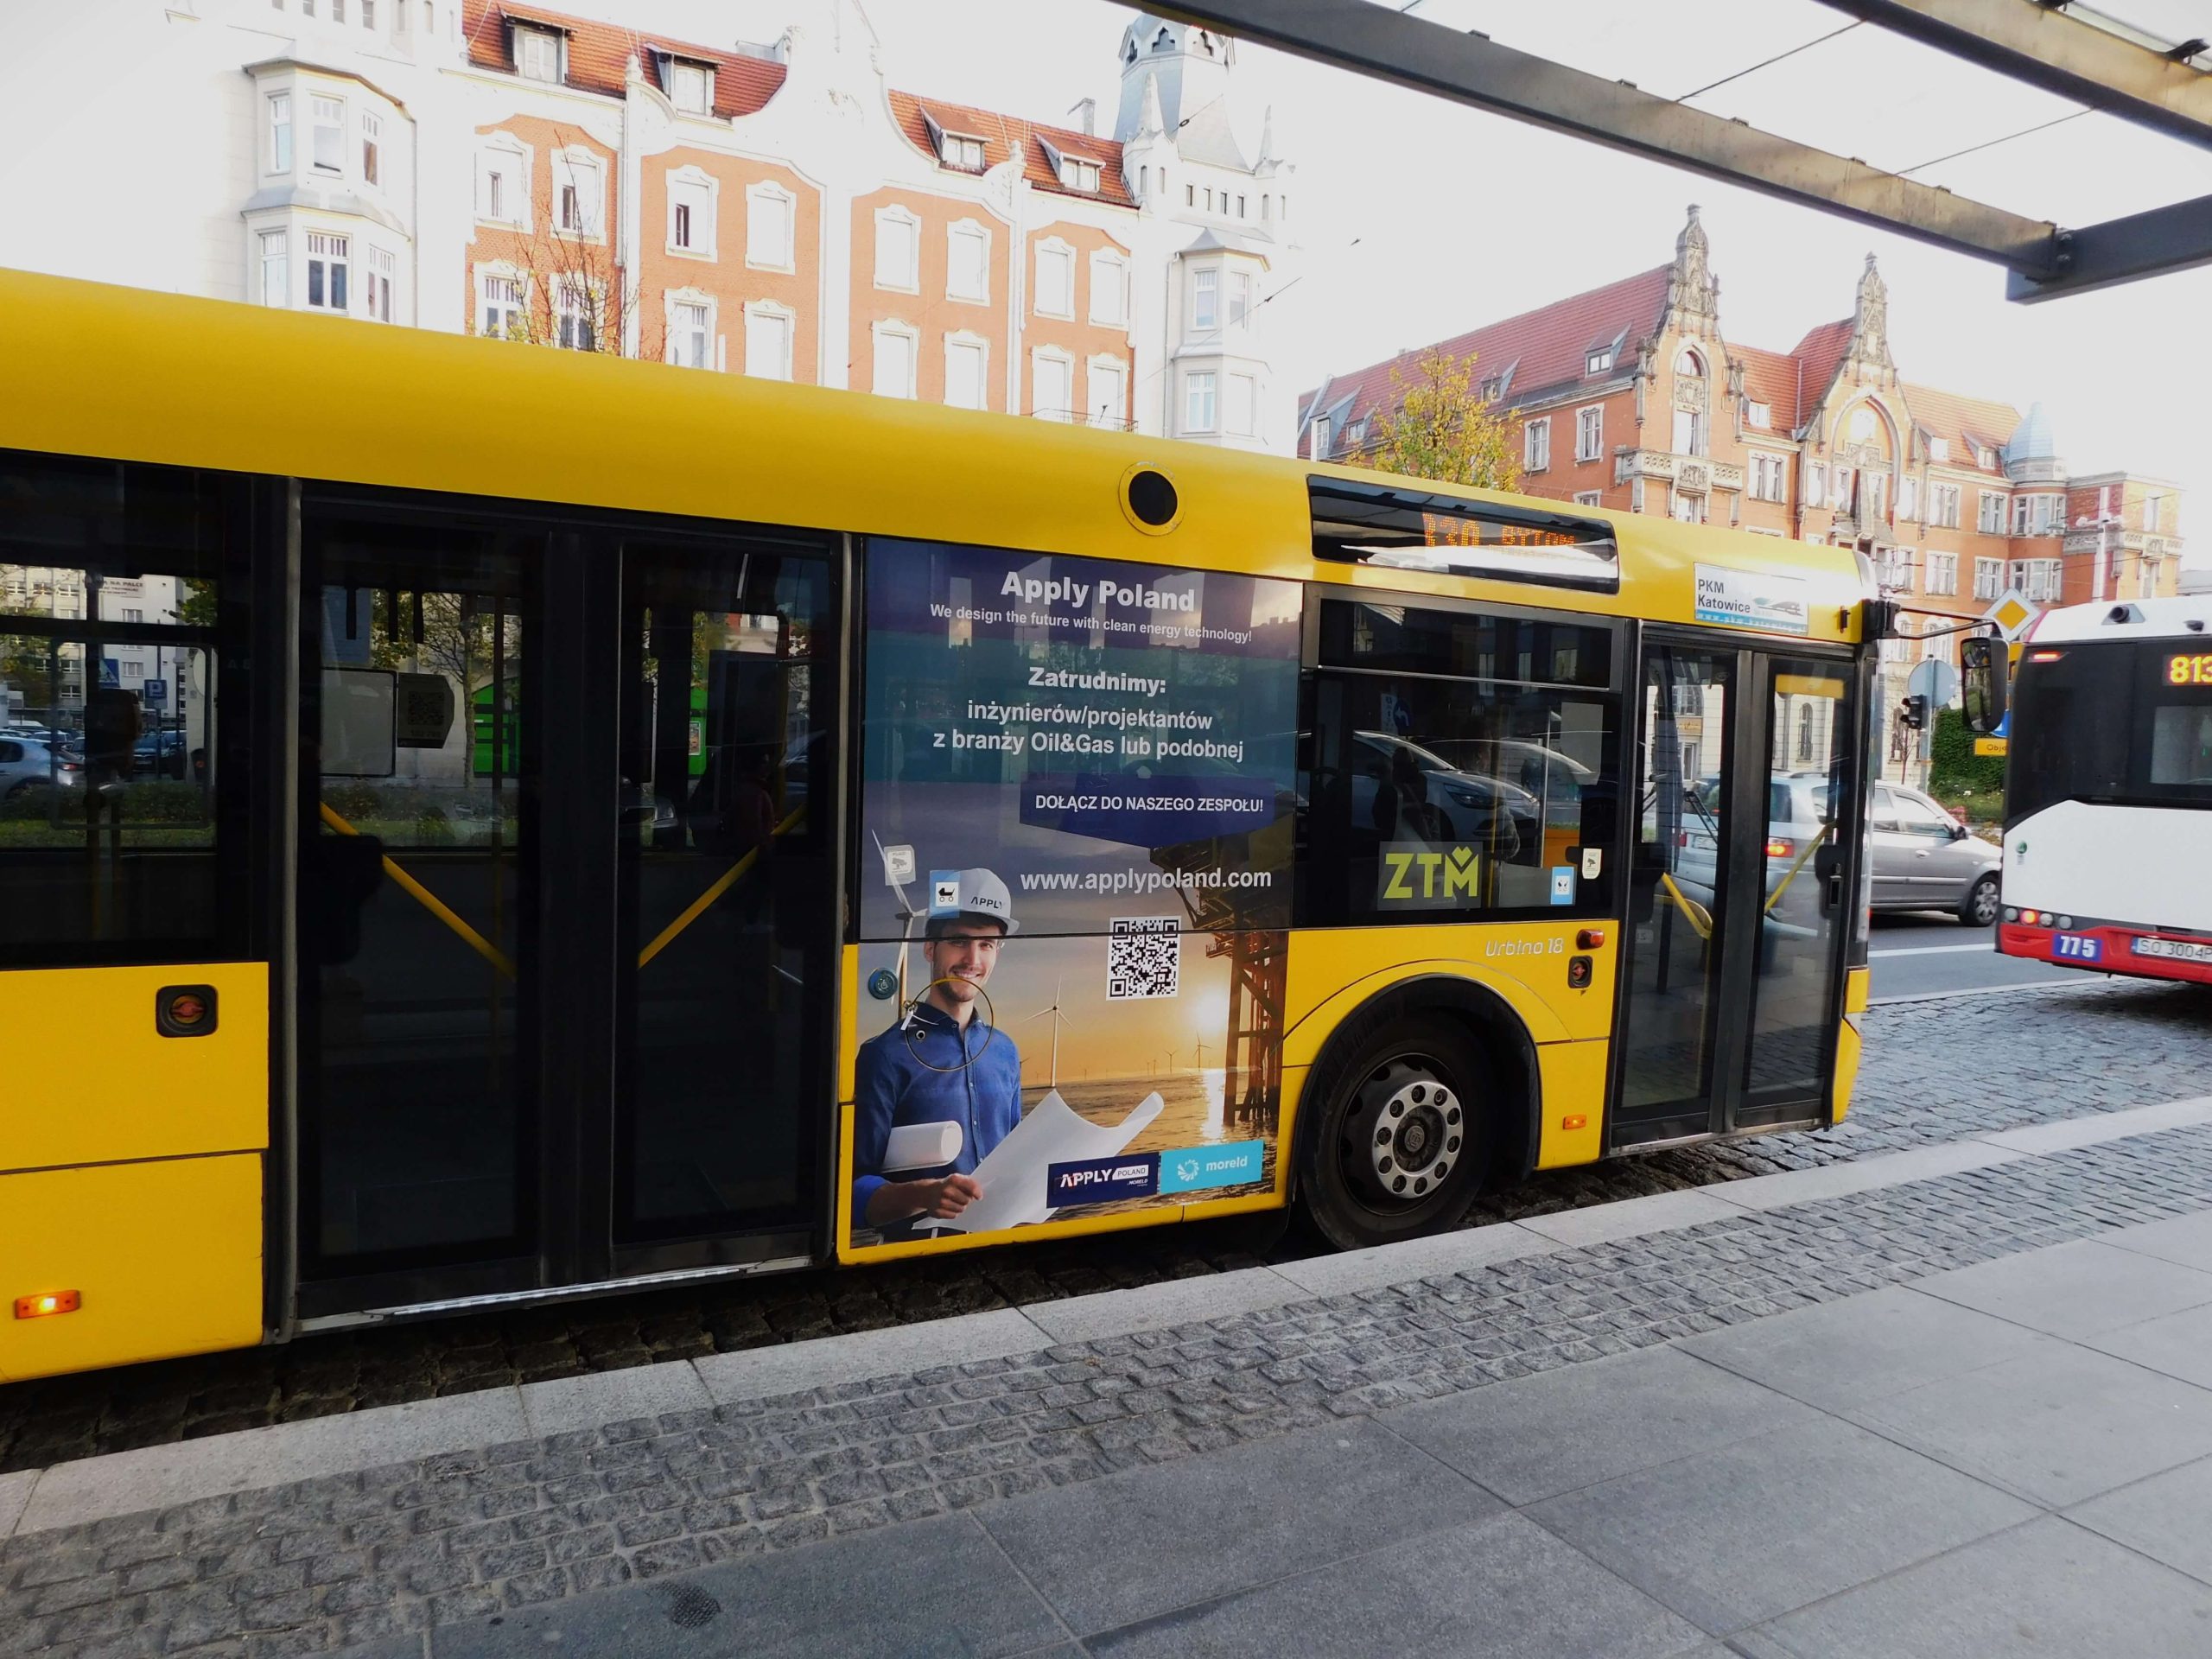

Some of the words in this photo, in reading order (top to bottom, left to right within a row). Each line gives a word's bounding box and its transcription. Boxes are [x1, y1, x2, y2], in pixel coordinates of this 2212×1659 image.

[1001, 571, 1090, 608] Apply
[1099, 580, 1195, 612] Poland
[1698, 579, 1724, 594] PKM
[1698, 594, 1751, 613] Katowice
[930, 604, 952, 618] We
[956, 606, 1002, 624] design
[1006, 610, 1027, 624] the
[1031, 612, 1070, 627] future
[1073, 616, 1099, 630] with
[1103, 619, 1136, 632] clean
[1140, 623, 1181, 639] energy
[1184, 625, 1252, 645] technology!
[1028, 666, 1166, 697] Zatrudnimy:
[2171, 656, 2212, 683] 813
[968, 700, 1213, 731] inżynierów/projektantów
[933, 733, 946, 747] z
[952, 728, 1025, 755] branży
[1031, 732, 1115, 754] Oil&Gas
[1121, 735, 1151, 755] lub
[1156, 738, 1243, 763] podobnej
[1036, 795, 1097, 813] DOŁĄCZ
[1101, 796, 1122, 810] DO
[1126, 797, 1194, 811] NASZEGO
[1197, 798, 1263, 812] ZESPOŁU!
[1020, 868, 1272, 894] www.applypoland.com
[1383, 846, 1479, 899] ZTM
[1485, 939, 1543, 957] Urbino
[1548, 938, 1564, 954] 18
[2060, 936, 2095, 958] 775
[2140, 939, 2160, 954] SO
[1206, 1156, 1248, 1172] moreld
[1059, 1169, 1113, 1188] APPLY
[1117, 1167, 1146, 1177] POLAND
